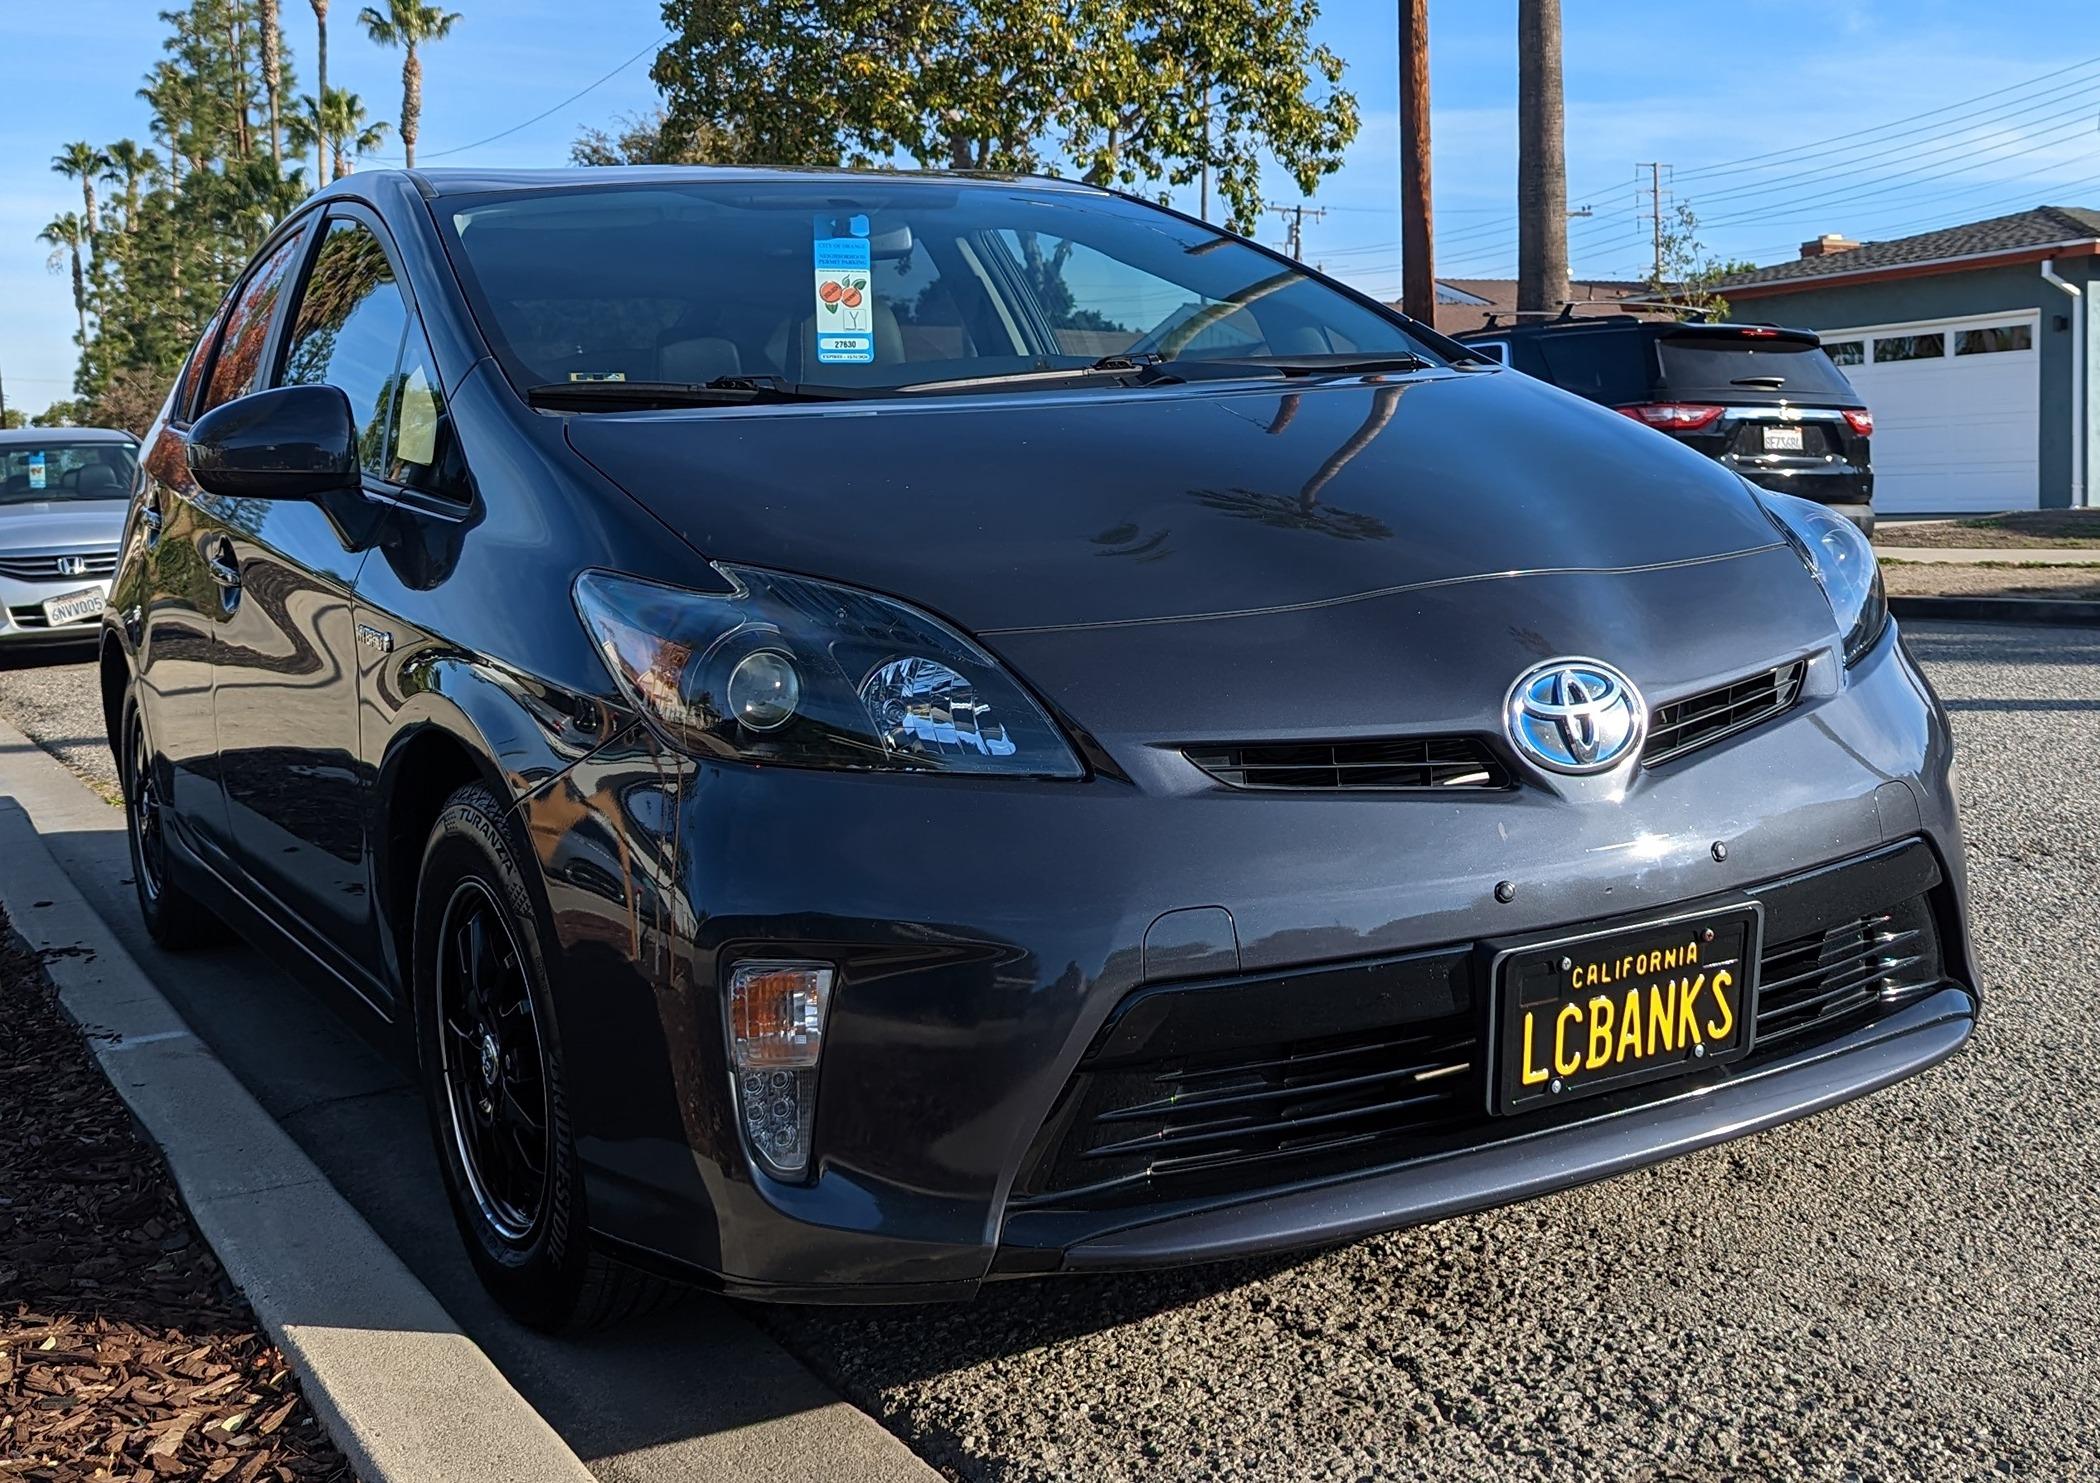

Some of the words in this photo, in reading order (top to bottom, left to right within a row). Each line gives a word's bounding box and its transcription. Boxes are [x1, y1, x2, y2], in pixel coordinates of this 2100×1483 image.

[834, 340, 857, 349] 27630
[52, 597, 103, 621] 6NVV005
[459, 808, 514, 876] TURANZA
[1571, 941, 1698, 989] CALIFORNIA
[1521, 969, 1733, 1085] LCBANKS
